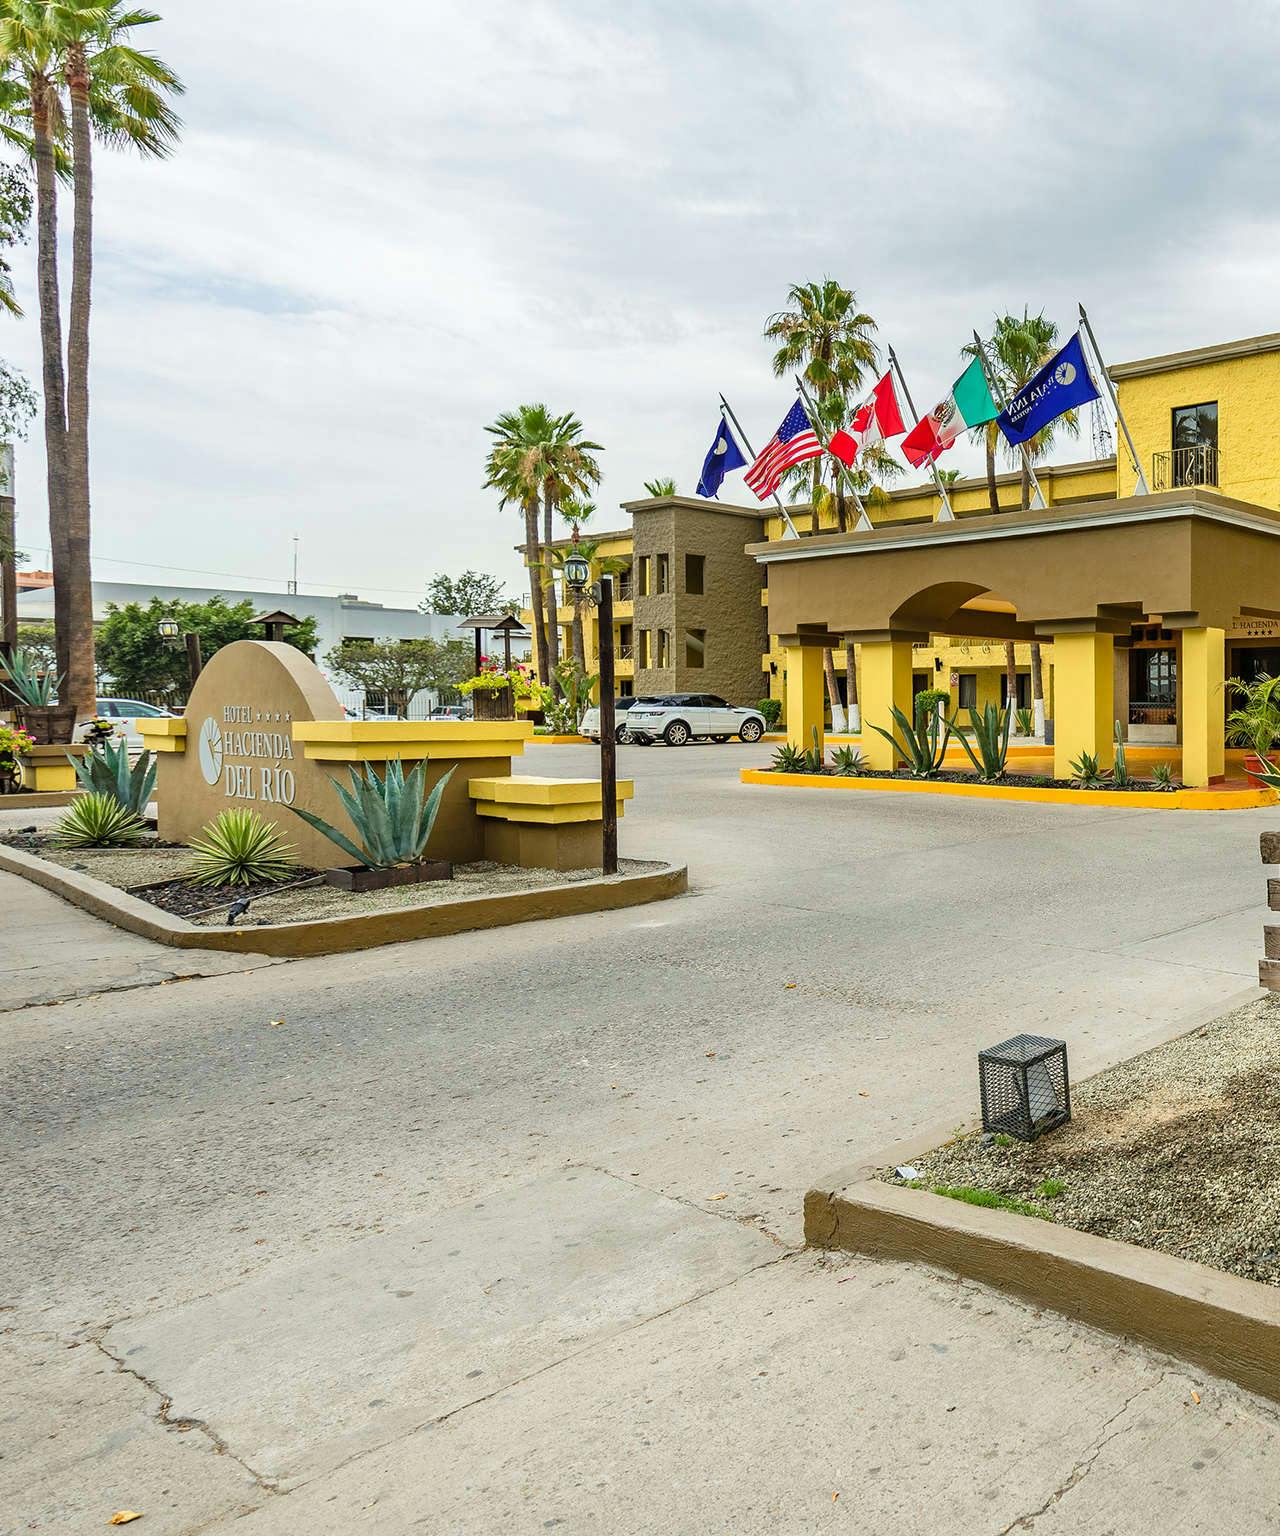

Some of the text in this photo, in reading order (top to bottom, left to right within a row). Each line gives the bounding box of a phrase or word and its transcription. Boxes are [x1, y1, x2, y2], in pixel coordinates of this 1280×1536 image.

[223, 706, 253, 724] HOTEL
[224, 731, 294, 760] HACIENDA
[224, 761, 296, 806] DEL RÍO
